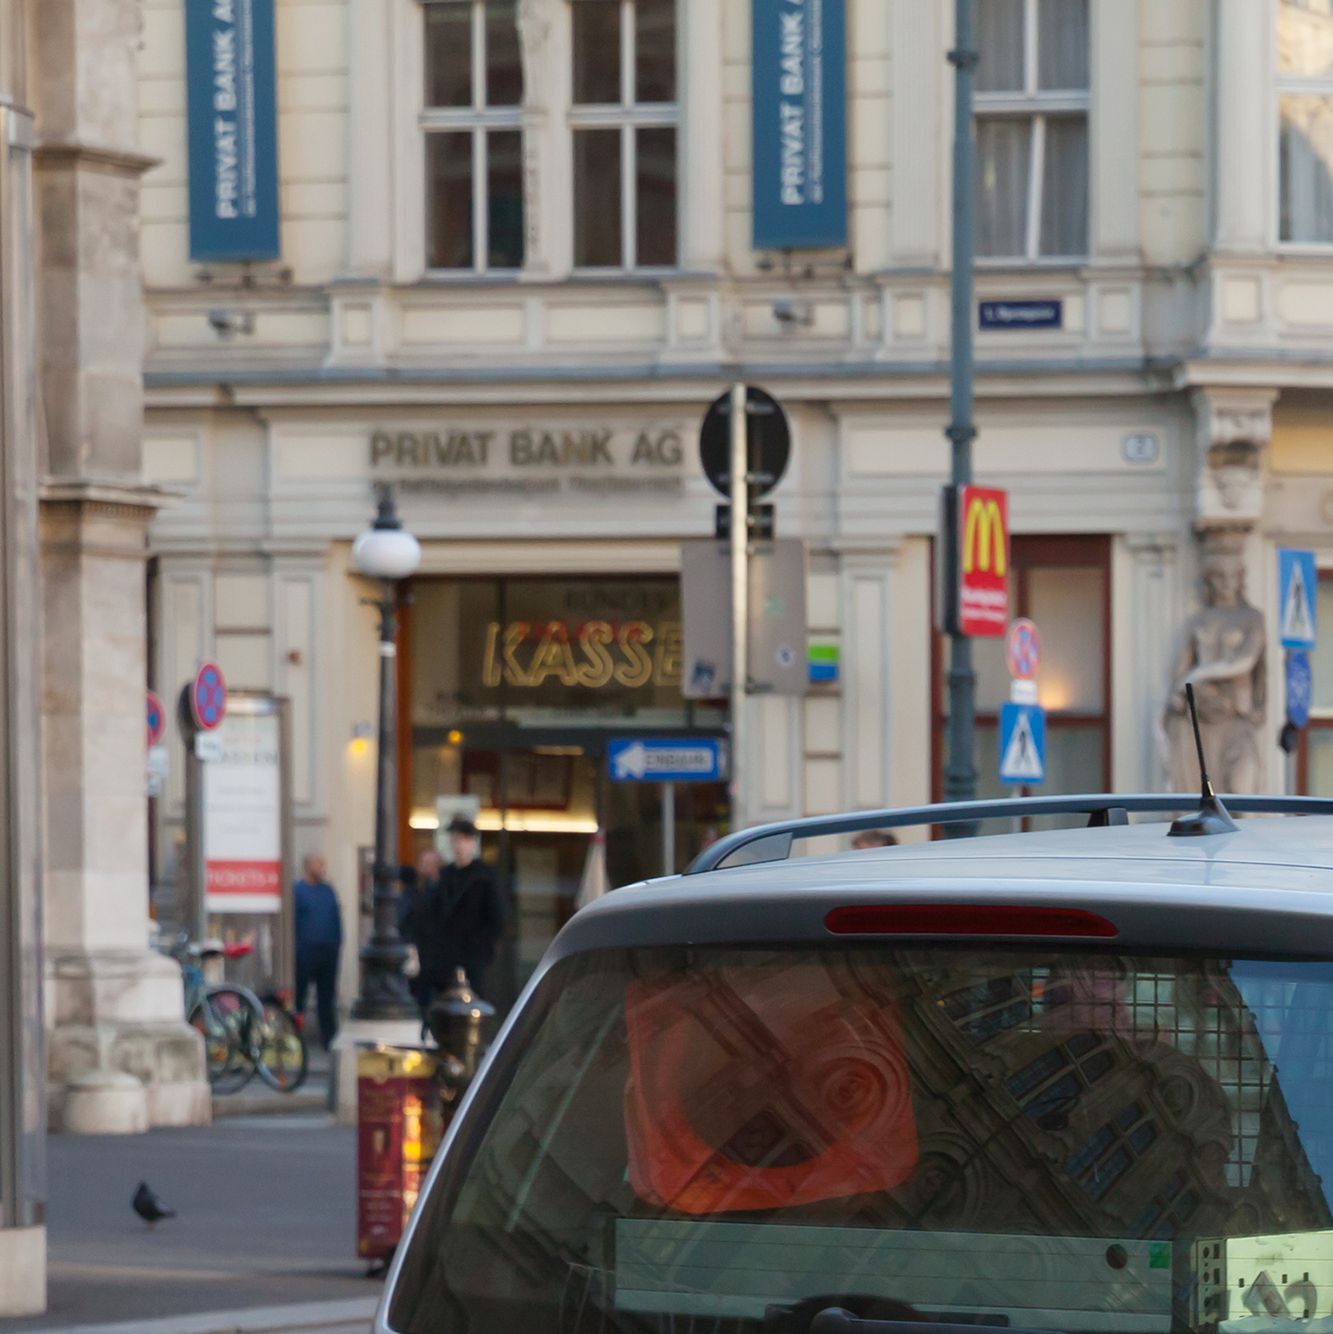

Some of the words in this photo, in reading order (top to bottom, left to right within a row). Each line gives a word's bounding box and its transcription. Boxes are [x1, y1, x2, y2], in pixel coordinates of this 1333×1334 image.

[212, 28, 237, 111] BANK
[779, 11, 804, 95] BANK
[215, 115, 239, 219] PRIVAT
[780, 101, 804, 205] PRIVAT
[370, 430, 497, 467] PRIVAT
[509, 429, 614, 467] BANK
[631, 431, 684, 467] AG
